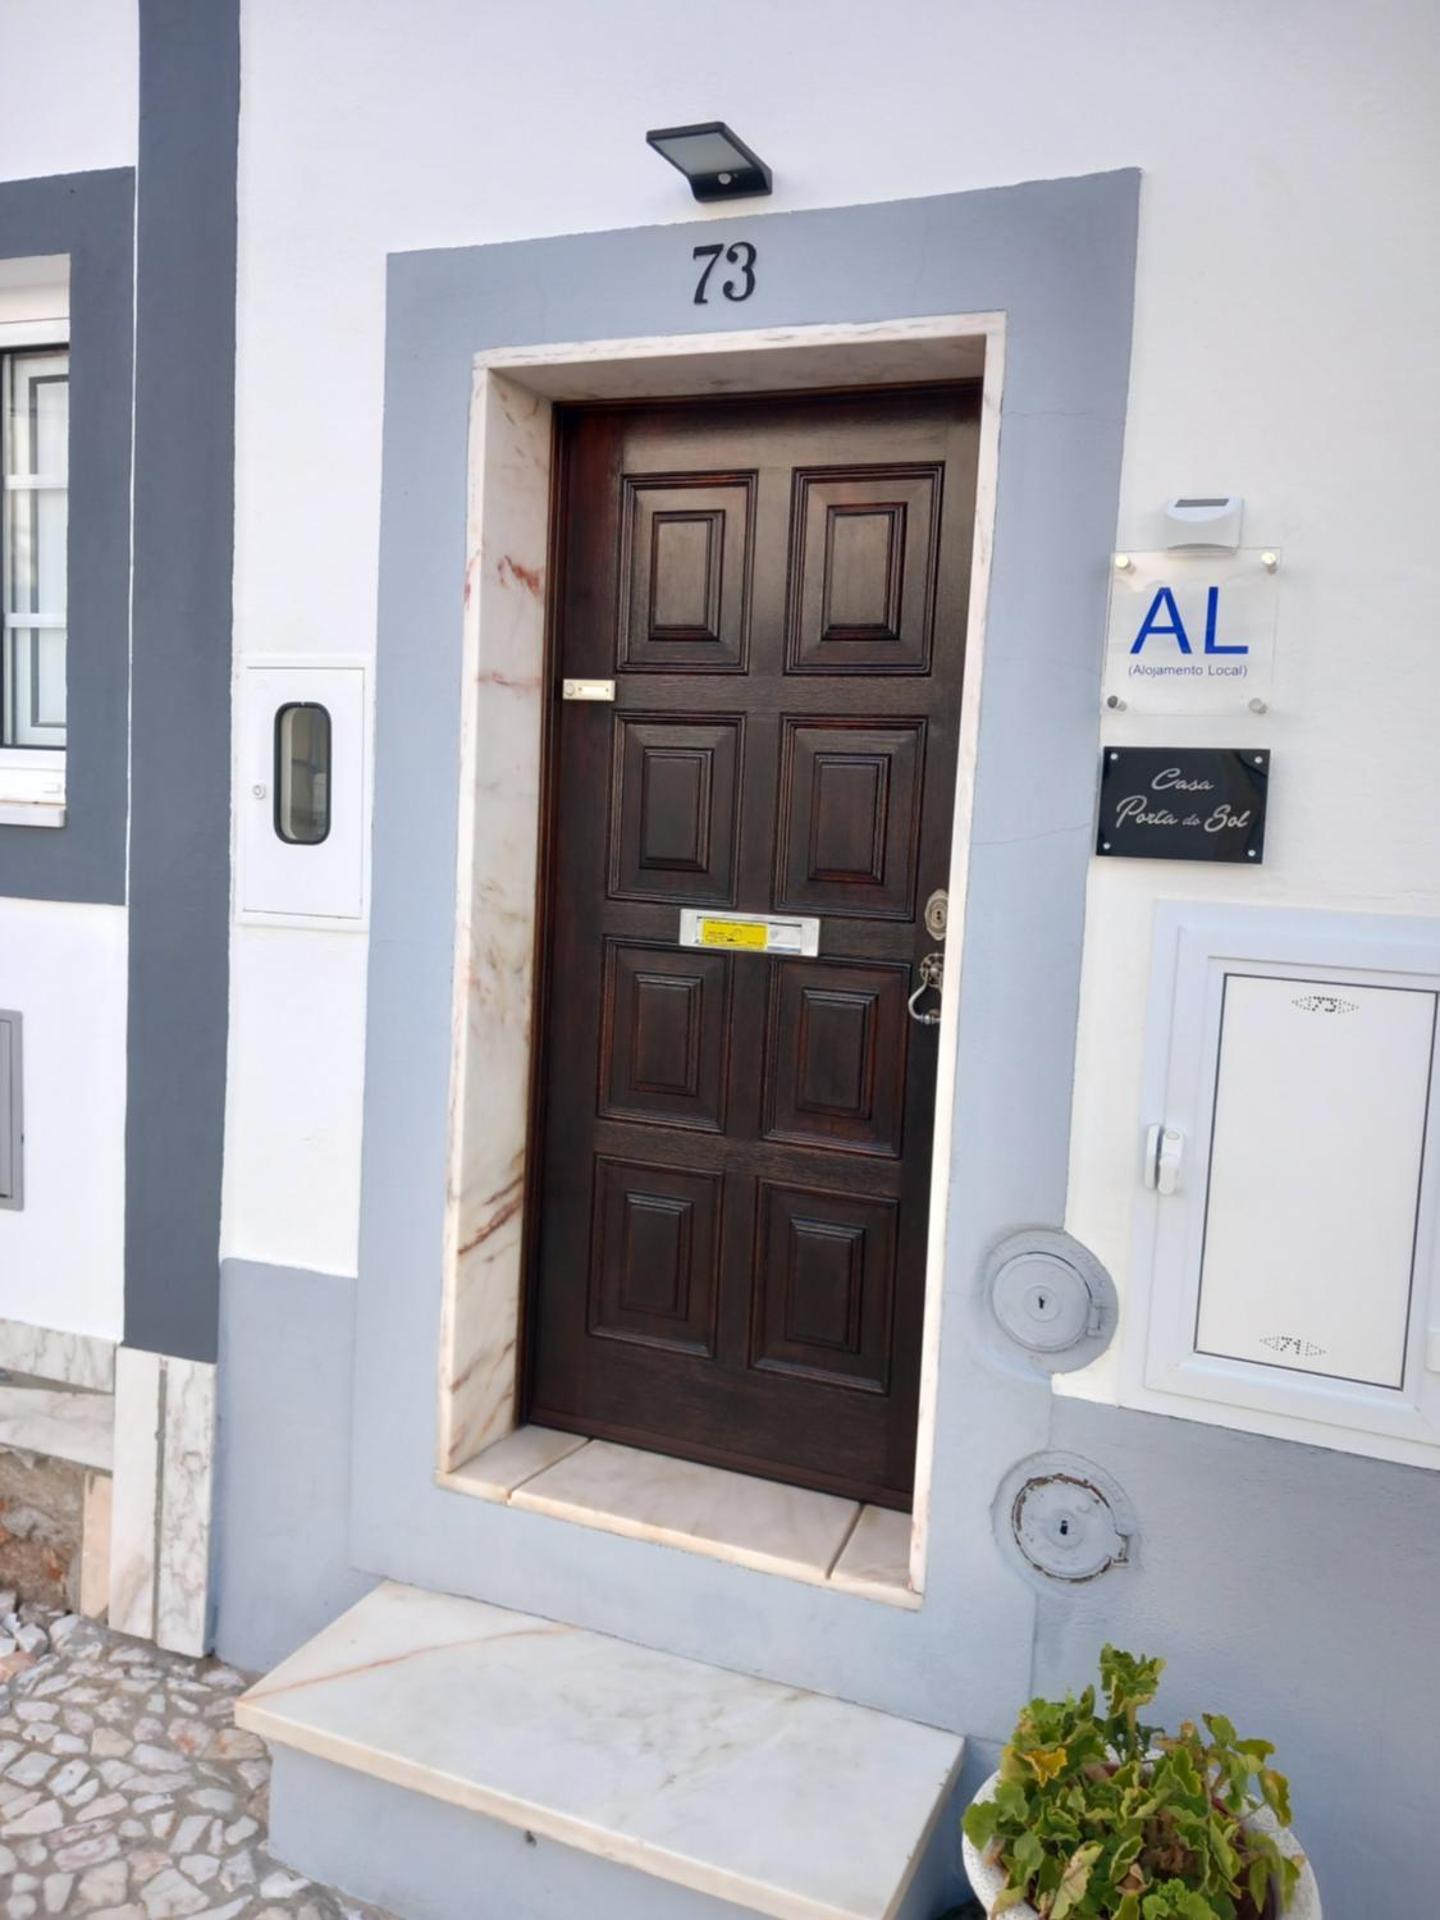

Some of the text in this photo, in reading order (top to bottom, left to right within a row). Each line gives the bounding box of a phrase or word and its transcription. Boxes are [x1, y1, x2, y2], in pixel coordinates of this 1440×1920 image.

[693, 241, 757, 305] 73
[1130, 586, 1249, 654] AL
[1128, 663, 1248, 678] (Alojamento Local)
[1151, 767, 1215, 790] Casa
[1116, 795, 1251, 832] Porta do Sol
[1311, 996, 1338, 1012] 73
[1279, 1336, 1302, 1354] 71
